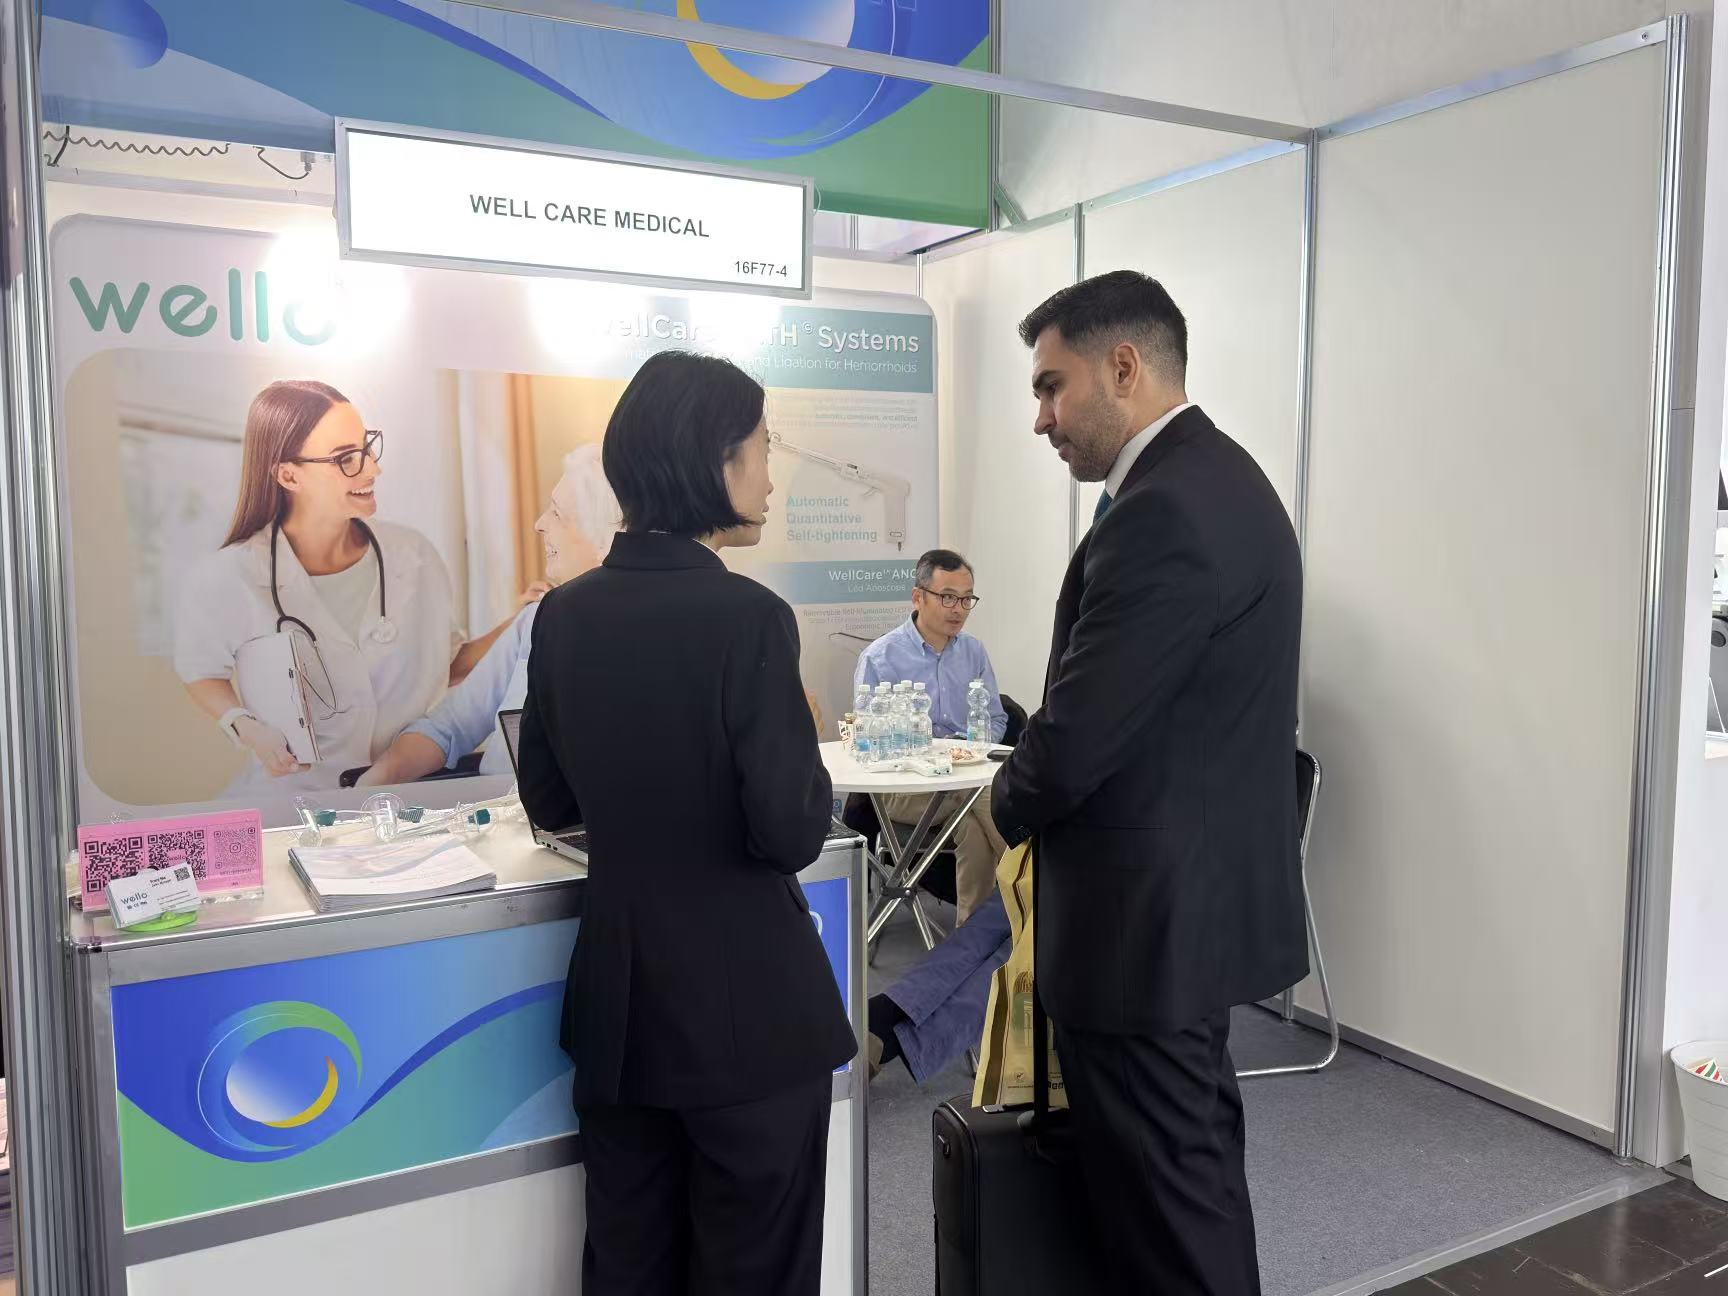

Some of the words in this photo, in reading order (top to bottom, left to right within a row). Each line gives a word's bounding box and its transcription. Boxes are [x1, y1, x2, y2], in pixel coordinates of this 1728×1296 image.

[469, 194, 537, 220] WELL
[543, 202, 607, 227] CARE
[614, 210, 710, 238] MEDICAL
[734, 261, 788, 278] 16F77-4
[817, 325, 920, 353] Systems
[773, 353, 822, 372] Ligation
[824, 357, 842, 370] for
[843, 359, 918, 374] Hemorrhoids
[786, 495, 849, 507] Automatic
[786, 513, 862, 526] Quantitative
[786, 530, 878, 542] Self-tightening
[121, 892, 148, 905] wello
